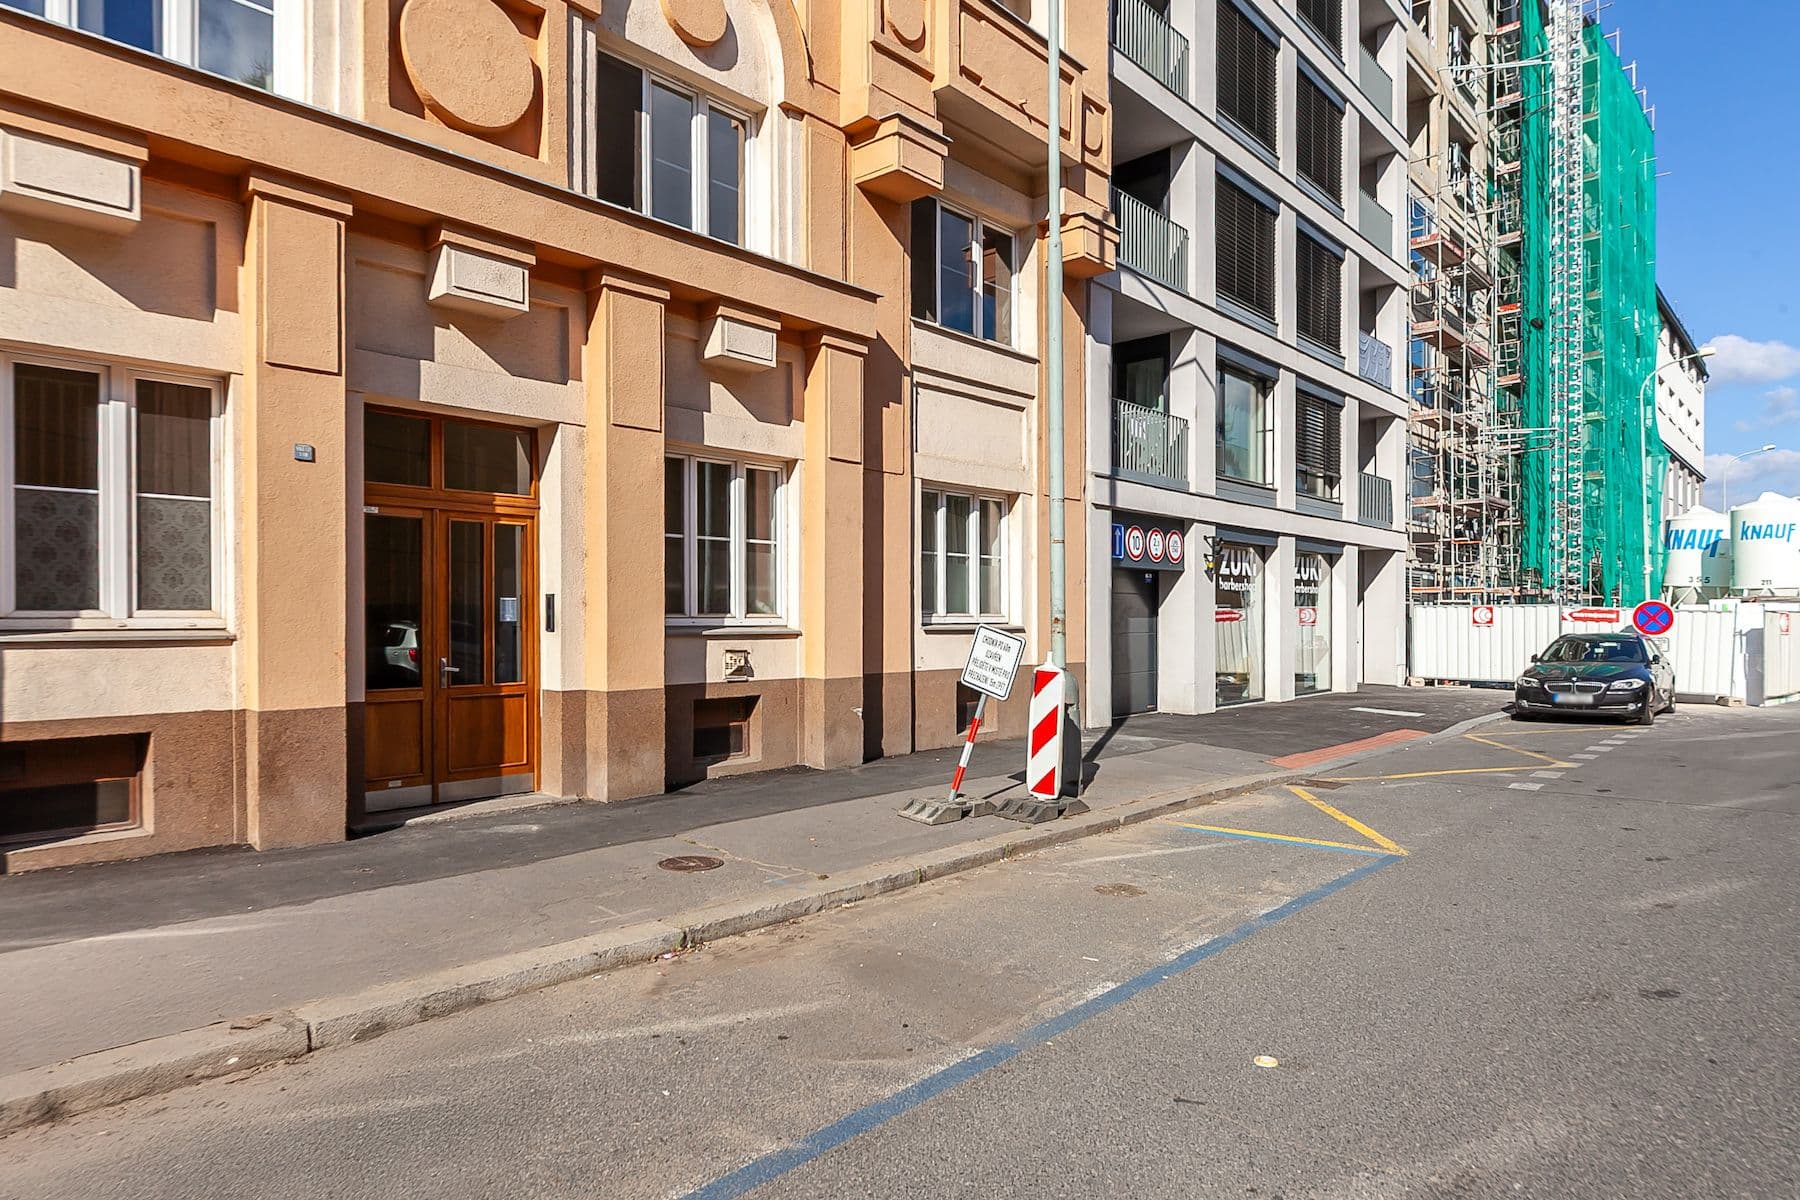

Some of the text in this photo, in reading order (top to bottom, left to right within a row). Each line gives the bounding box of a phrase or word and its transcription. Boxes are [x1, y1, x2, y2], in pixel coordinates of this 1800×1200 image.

[1665, 520, 1723, 557] KNAUF
[1741, 521, 1796, 542] KNAUF
[1132, 535, 1141, 551] 10
[1219, 576, 1256, 592] barbershop
